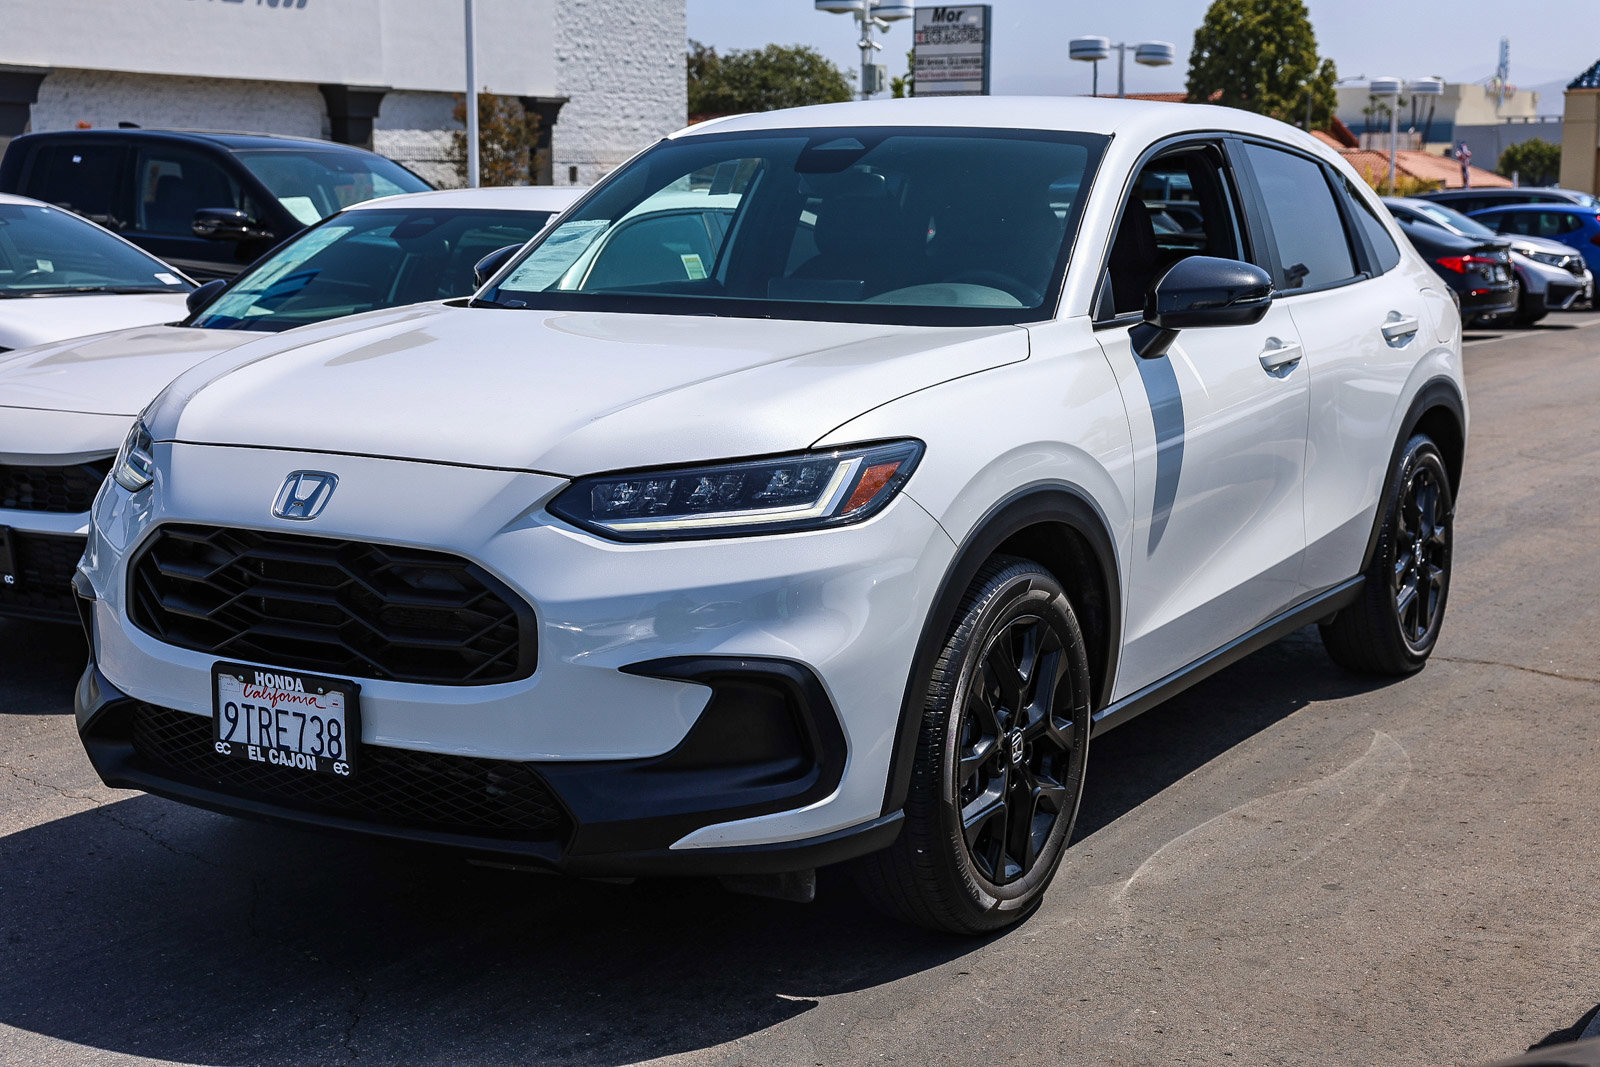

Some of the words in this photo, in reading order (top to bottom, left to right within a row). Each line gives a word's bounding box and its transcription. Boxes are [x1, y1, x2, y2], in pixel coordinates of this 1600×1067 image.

[932, 7, 964, 23] Mor
[254, 671, 305, 693] HONDA
[243, 683, 326, 709] California
[224, 701, 342, 759] 9TRE738
[247, 745, 266, 762] EL
[268, 750, 317, 771] CAJON
